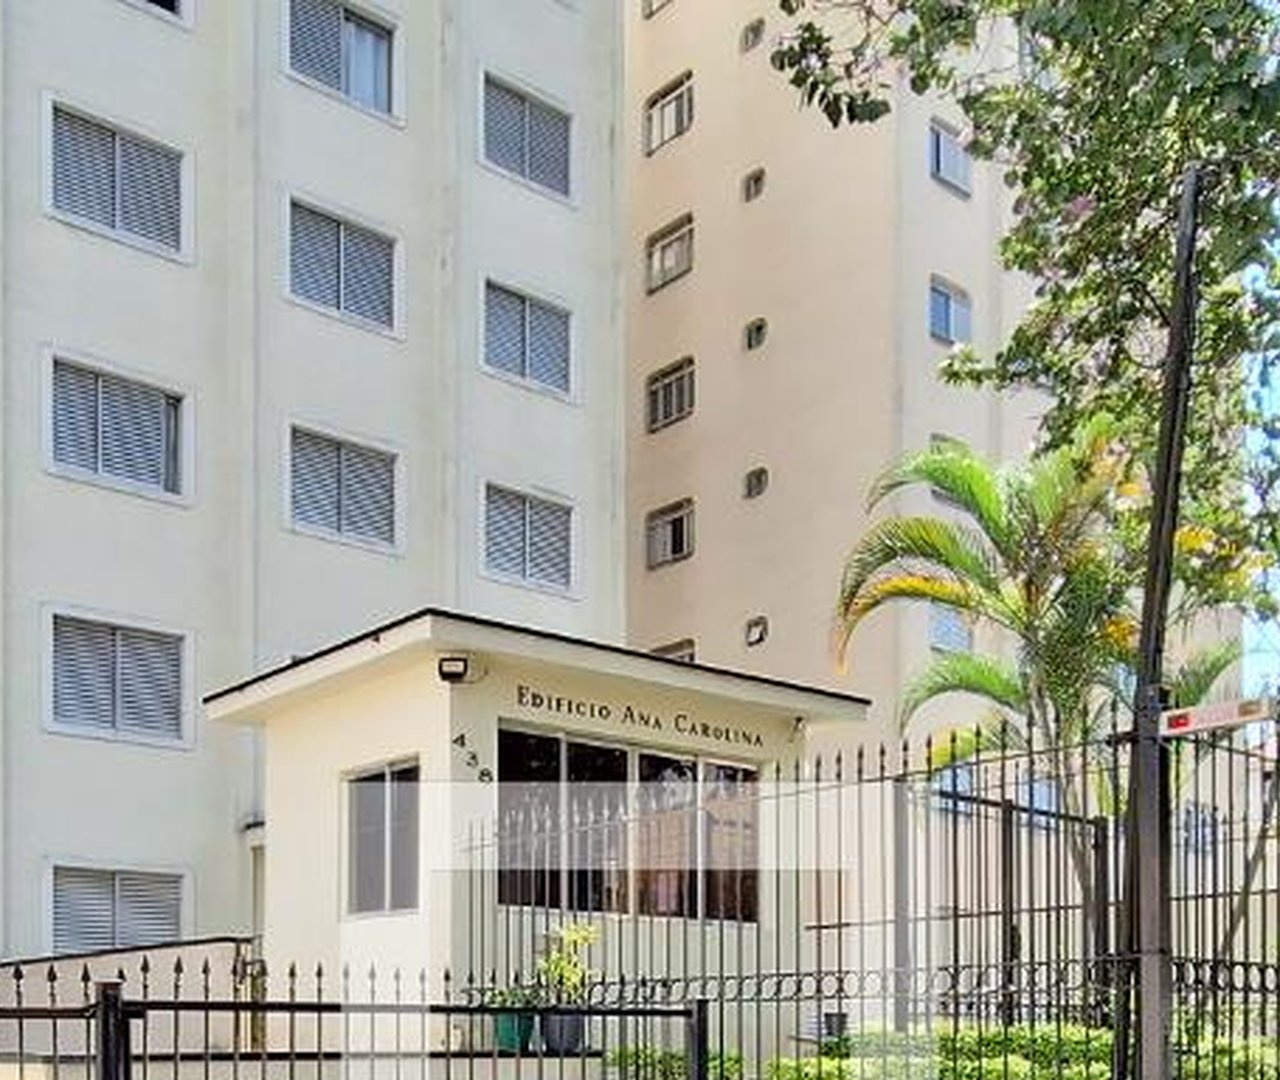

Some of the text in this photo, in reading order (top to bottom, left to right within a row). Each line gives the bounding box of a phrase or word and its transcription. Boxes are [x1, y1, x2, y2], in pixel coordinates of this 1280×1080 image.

[517, 684, 763, 747] EDIFICIO ANA CAROLINA
[451, 733, 493, 784] 438
